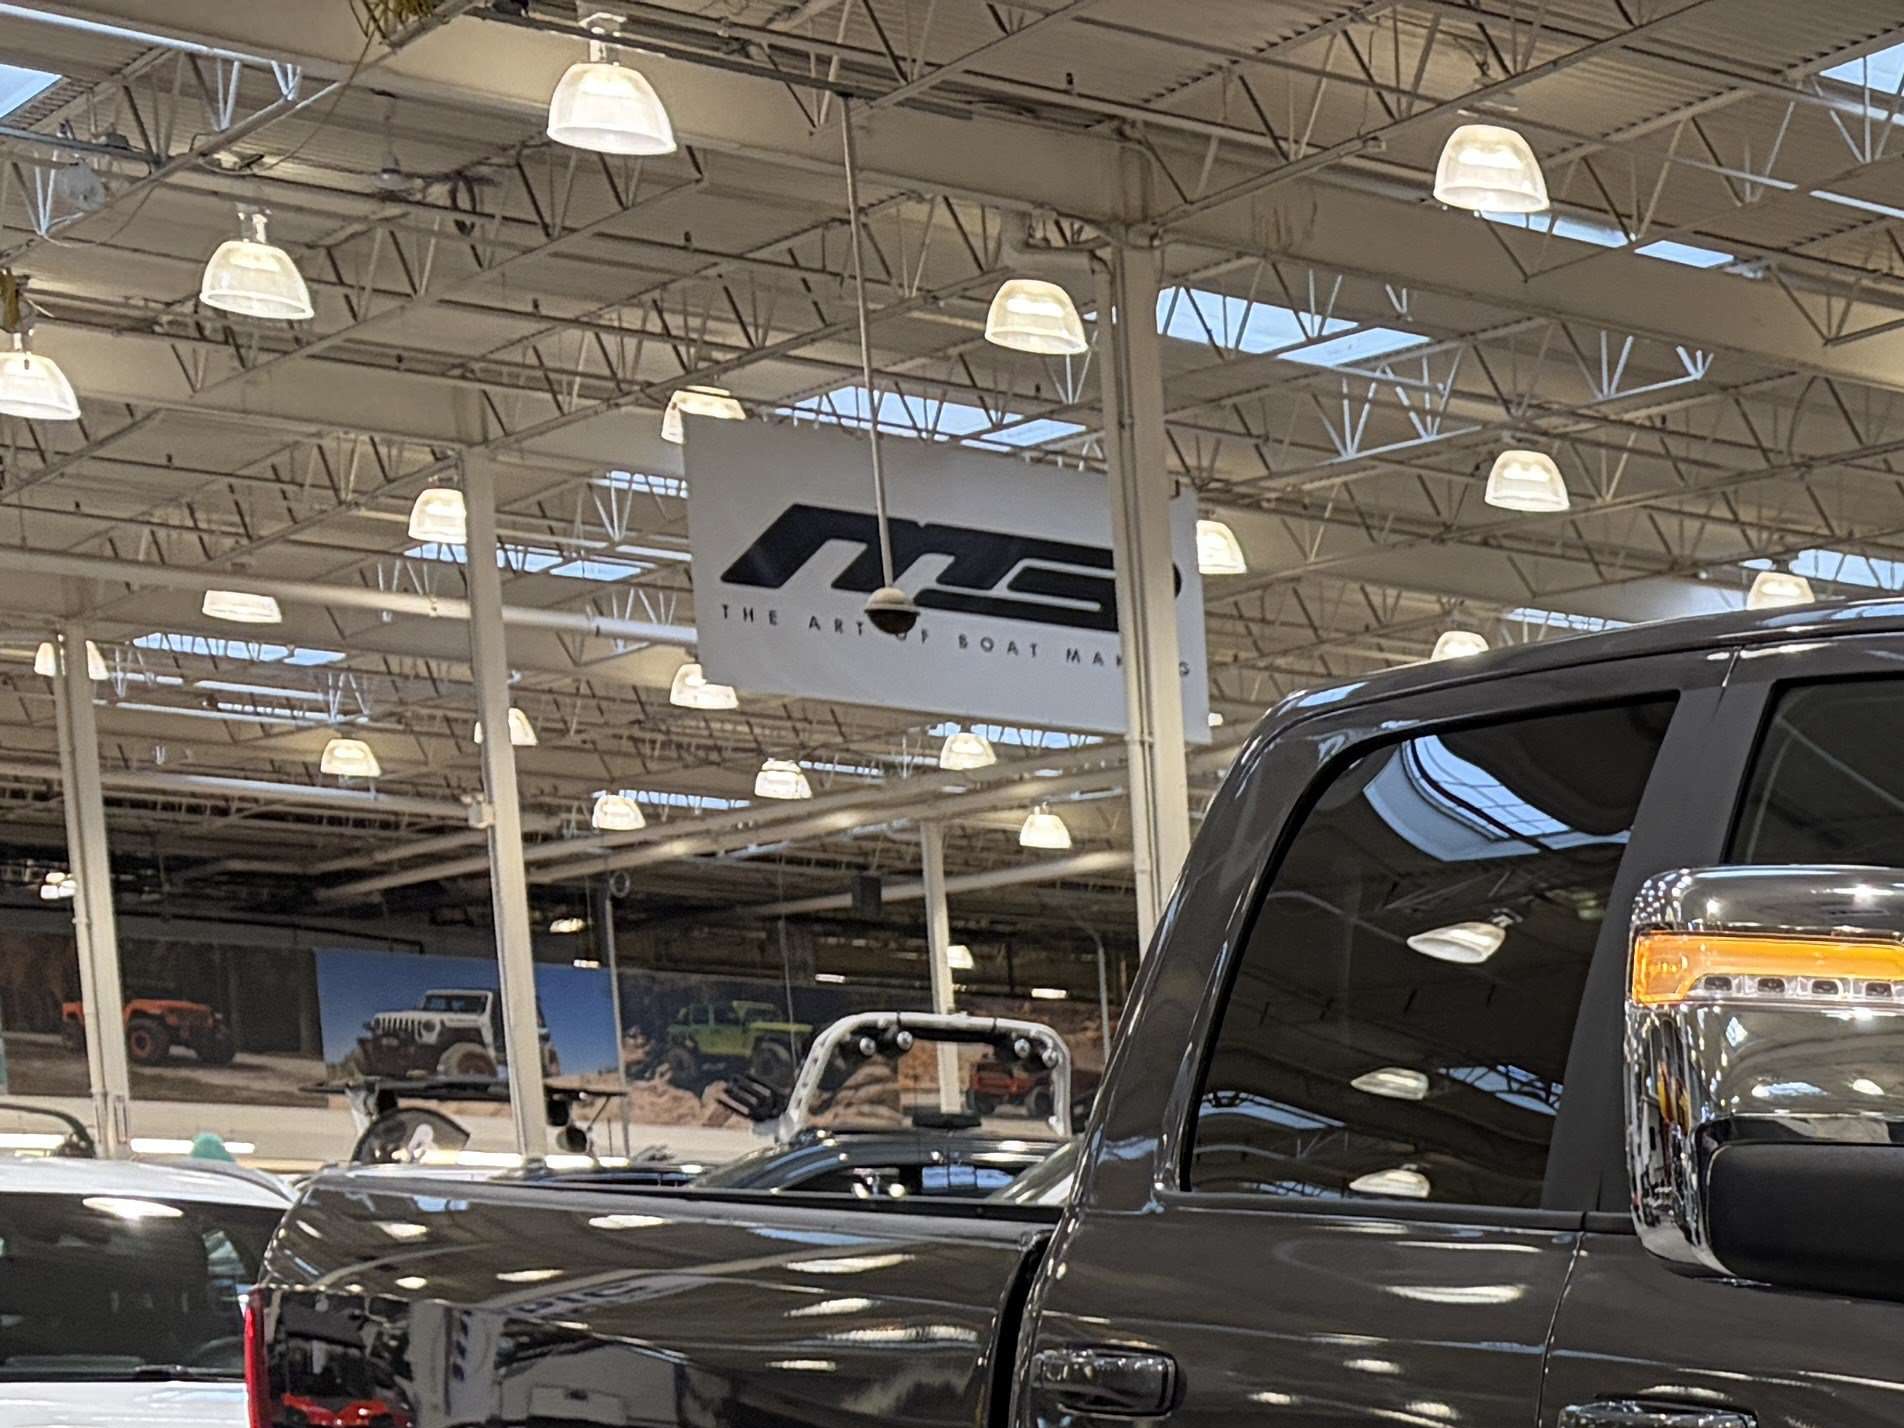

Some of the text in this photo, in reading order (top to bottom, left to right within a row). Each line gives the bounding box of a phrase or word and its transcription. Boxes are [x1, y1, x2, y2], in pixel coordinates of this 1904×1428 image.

[721, 604, 779, 627] THE
[808, 615, 865, 637] ART
[958, 632, 1038, 658] BOAT
